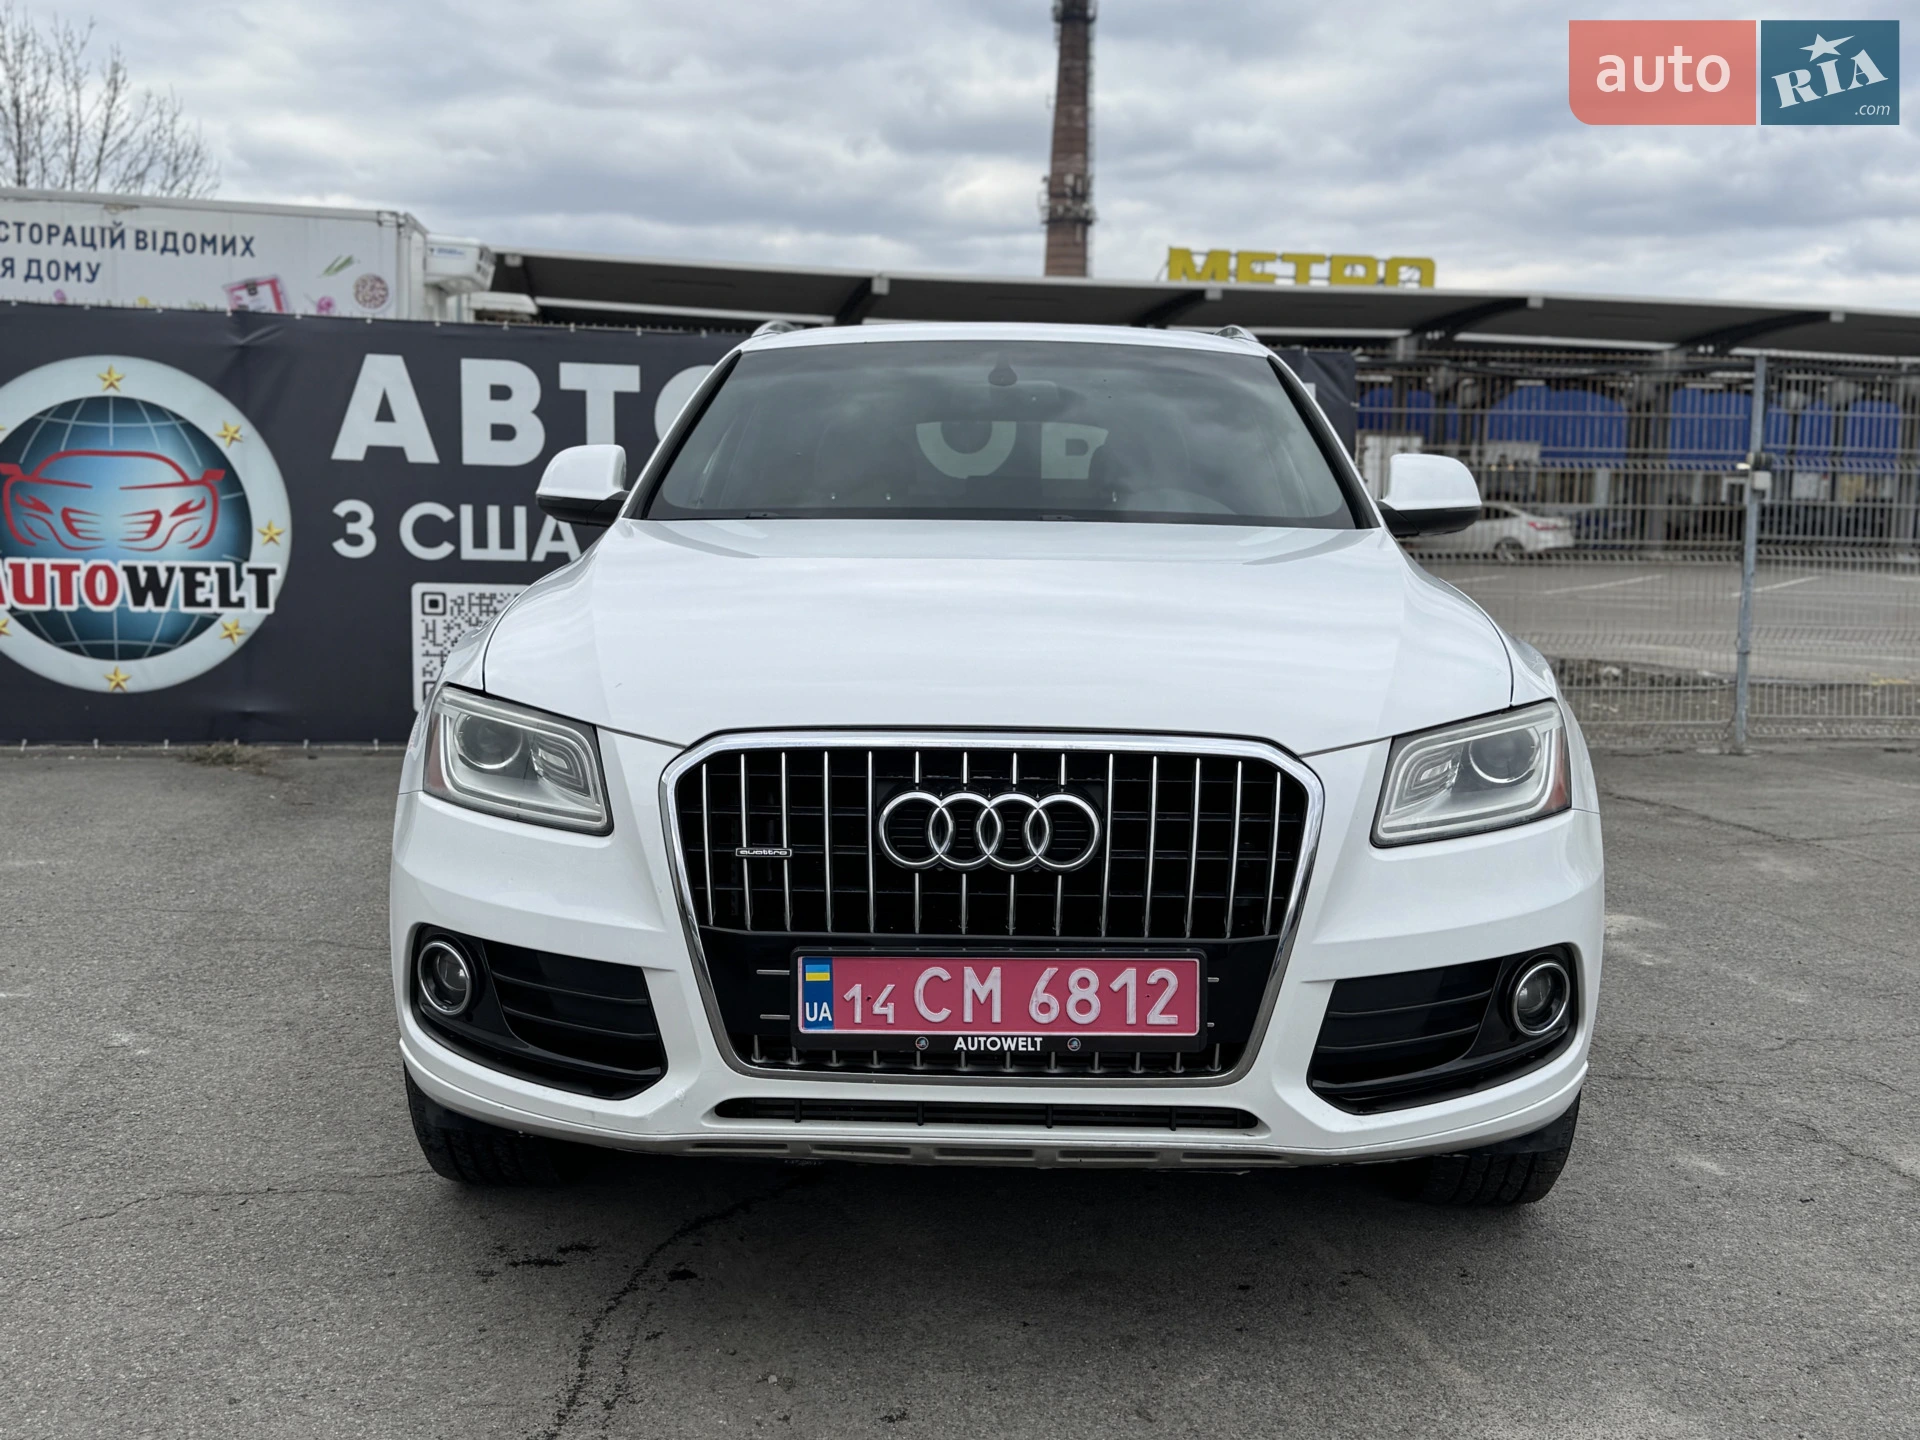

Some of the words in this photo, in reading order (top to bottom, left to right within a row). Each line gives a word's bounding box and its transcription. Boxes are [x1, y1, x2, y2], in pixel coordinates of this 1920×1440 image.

[135, 229, 255, 257] ВІДОМИХ
[0, 257, 14, 278] Я
[24, 259, 101, 283] ДОМУ
[1168, 247, 1435, 287] METRO
[331, 353, 713, 466] АВТ
[400, 502, 582, 562] США
[0, 561, 278, 610] UTOWELT
[805, 1002, 833, 1022] UA
[844, 984, 895, 1024] 14
[914, 966, 1001, 1024] CM
[1029, 968, 1179, 1024] 6812
[954, 1037, 1043, 1051] AUTOWELT
